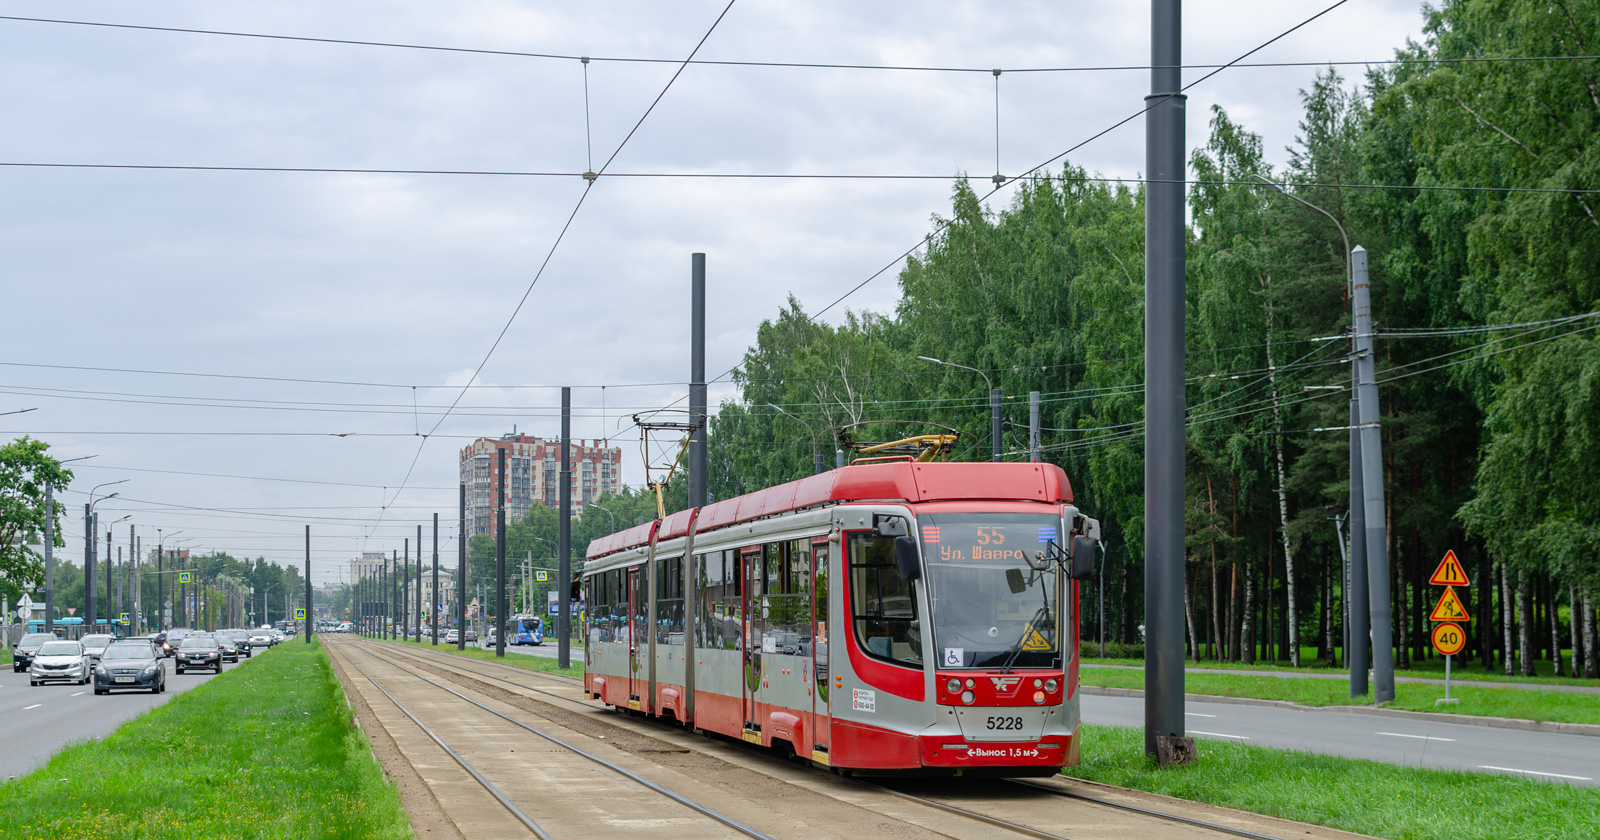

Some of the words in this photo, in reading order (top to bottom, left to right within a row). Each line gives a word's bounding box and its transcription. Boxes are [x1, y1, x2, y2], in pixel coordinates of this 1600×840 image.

[977, 527, 1005, 544] 55
[941, 545, 965, 560] Ул.
[1439, 632, 1458, 645] 40
[986, 716, 1023, 730] 5228
[976, 748, 1006, 757] Вынос
[1009, 748, 1021, 758] 1,5
